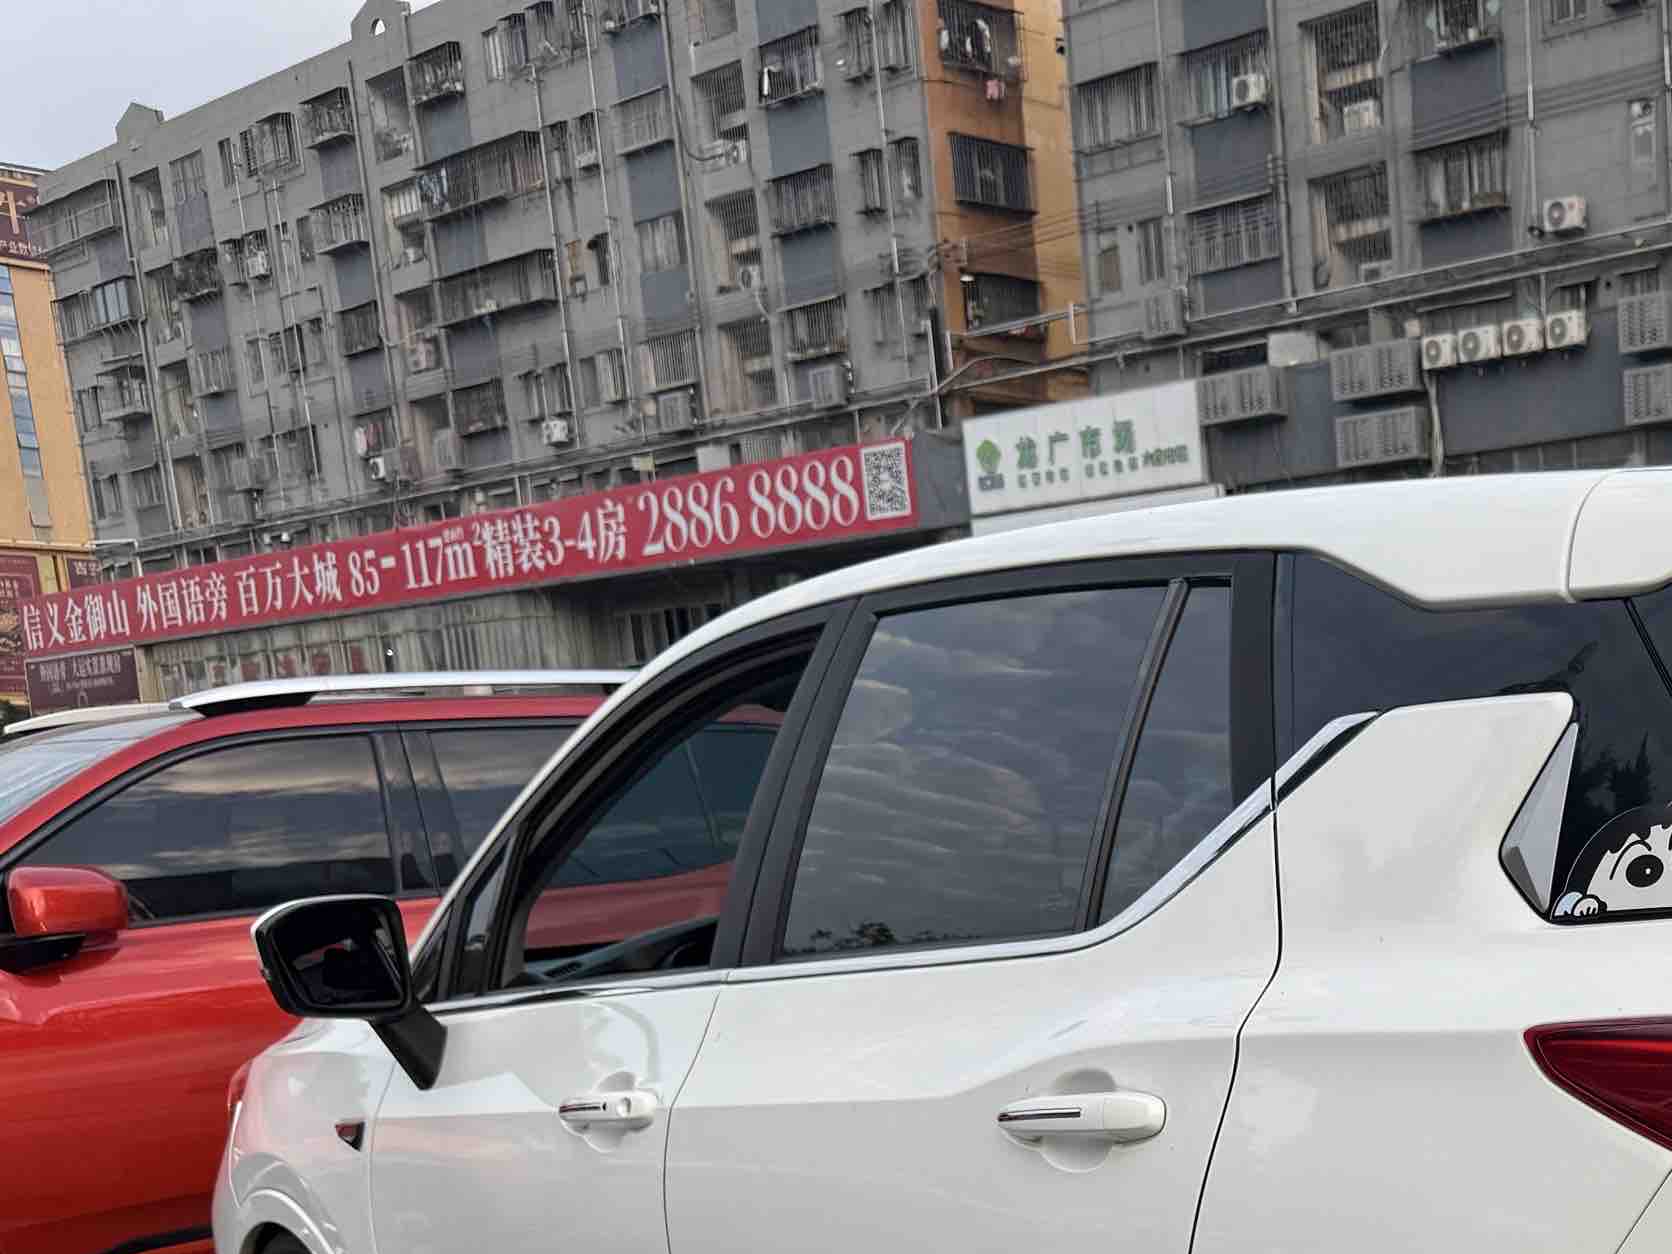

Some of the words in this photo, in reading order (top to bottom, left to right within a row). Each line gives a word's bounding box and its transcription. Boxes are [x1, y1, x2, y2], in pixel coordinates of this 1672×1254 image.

[23, 589, 130, 650] 信义金御山
[136, 570, 228, 633] 外国语旁
[234, 551, 342, 616] 百万大城
[638, 476, 740, 556] 2886
[749, 455, 860, 539] 8888
